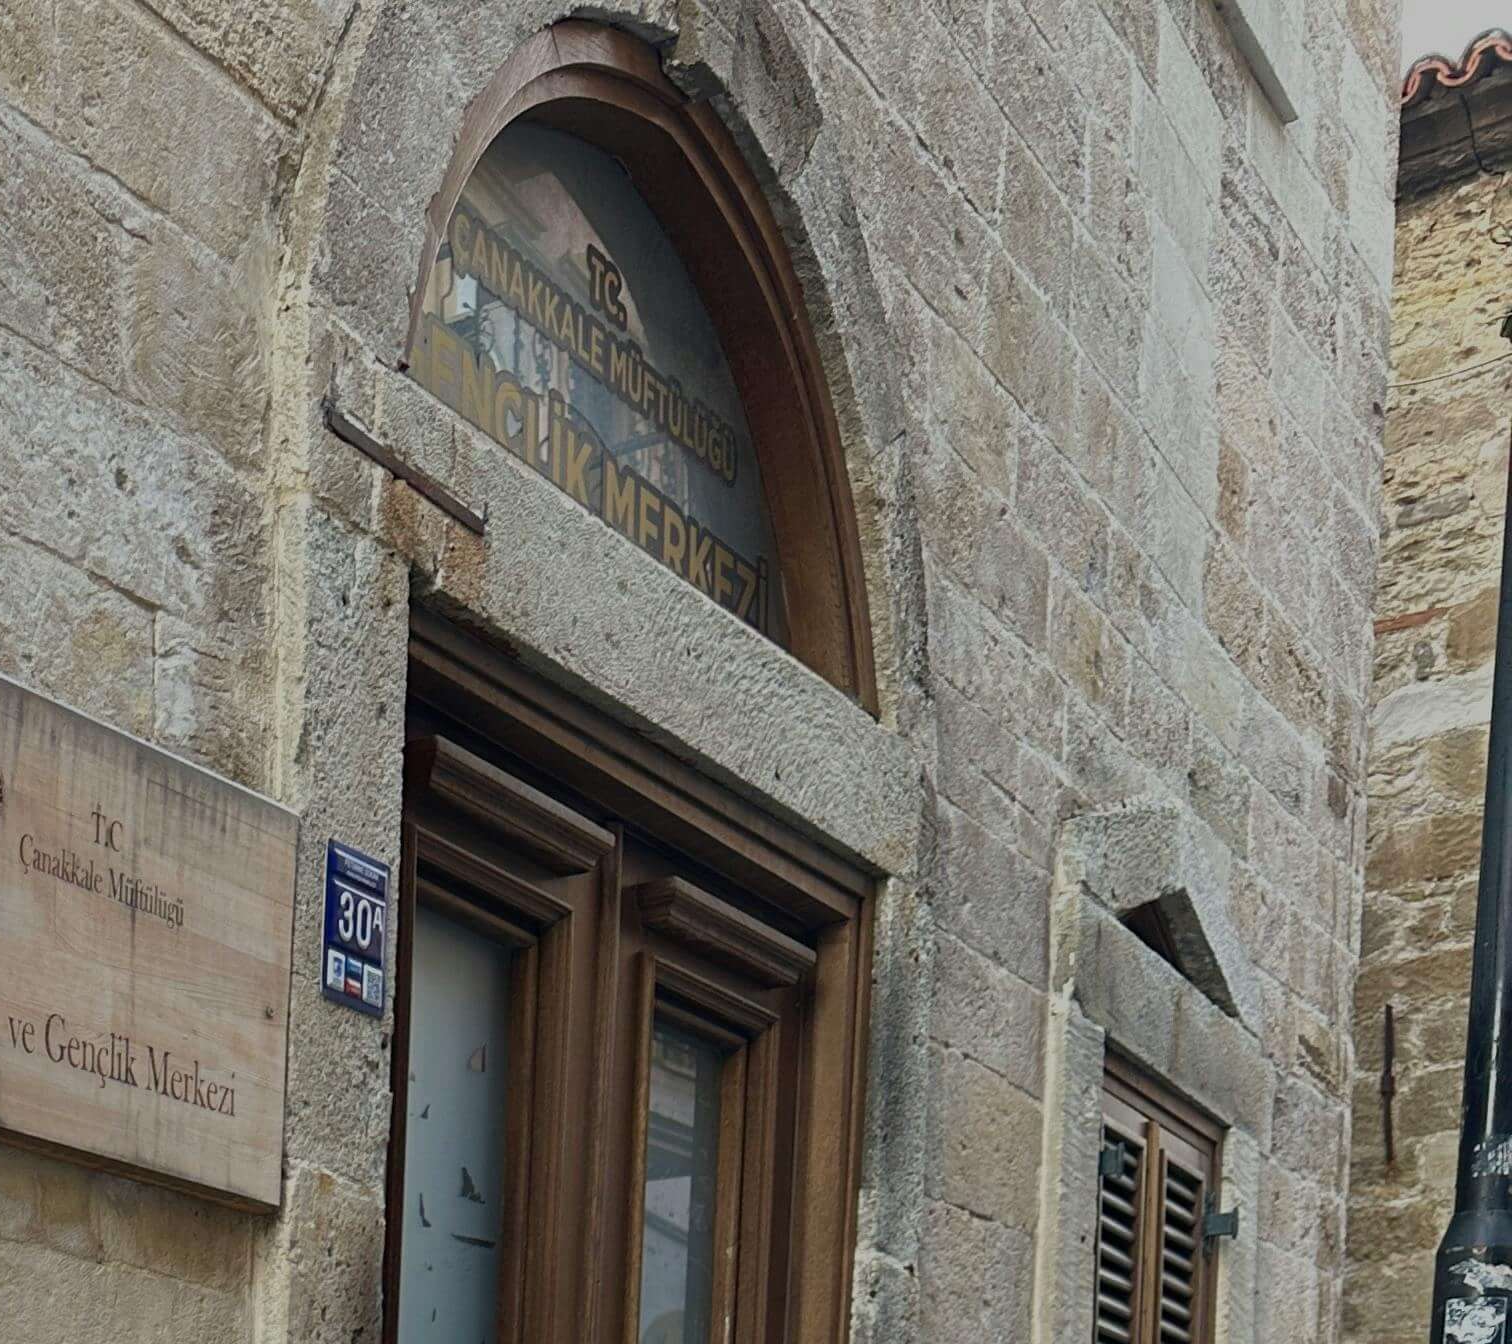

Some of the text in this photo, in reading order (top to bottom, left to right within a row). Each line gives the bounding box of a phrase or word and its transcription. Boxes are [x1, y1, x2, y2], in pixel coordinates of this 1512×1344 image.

[453, 212, 737, 483] ÇANAKKALE MÜFTÜLÜĞÜ
[19, 833, 104, 895] Çanakkale
[338, 890, 384, 951] 30A
[8, 1016, 35, 1054] ve
[44, 1012, 138, 1089] Gençlik
[145, 1044, 236, 1118] Merkezi
